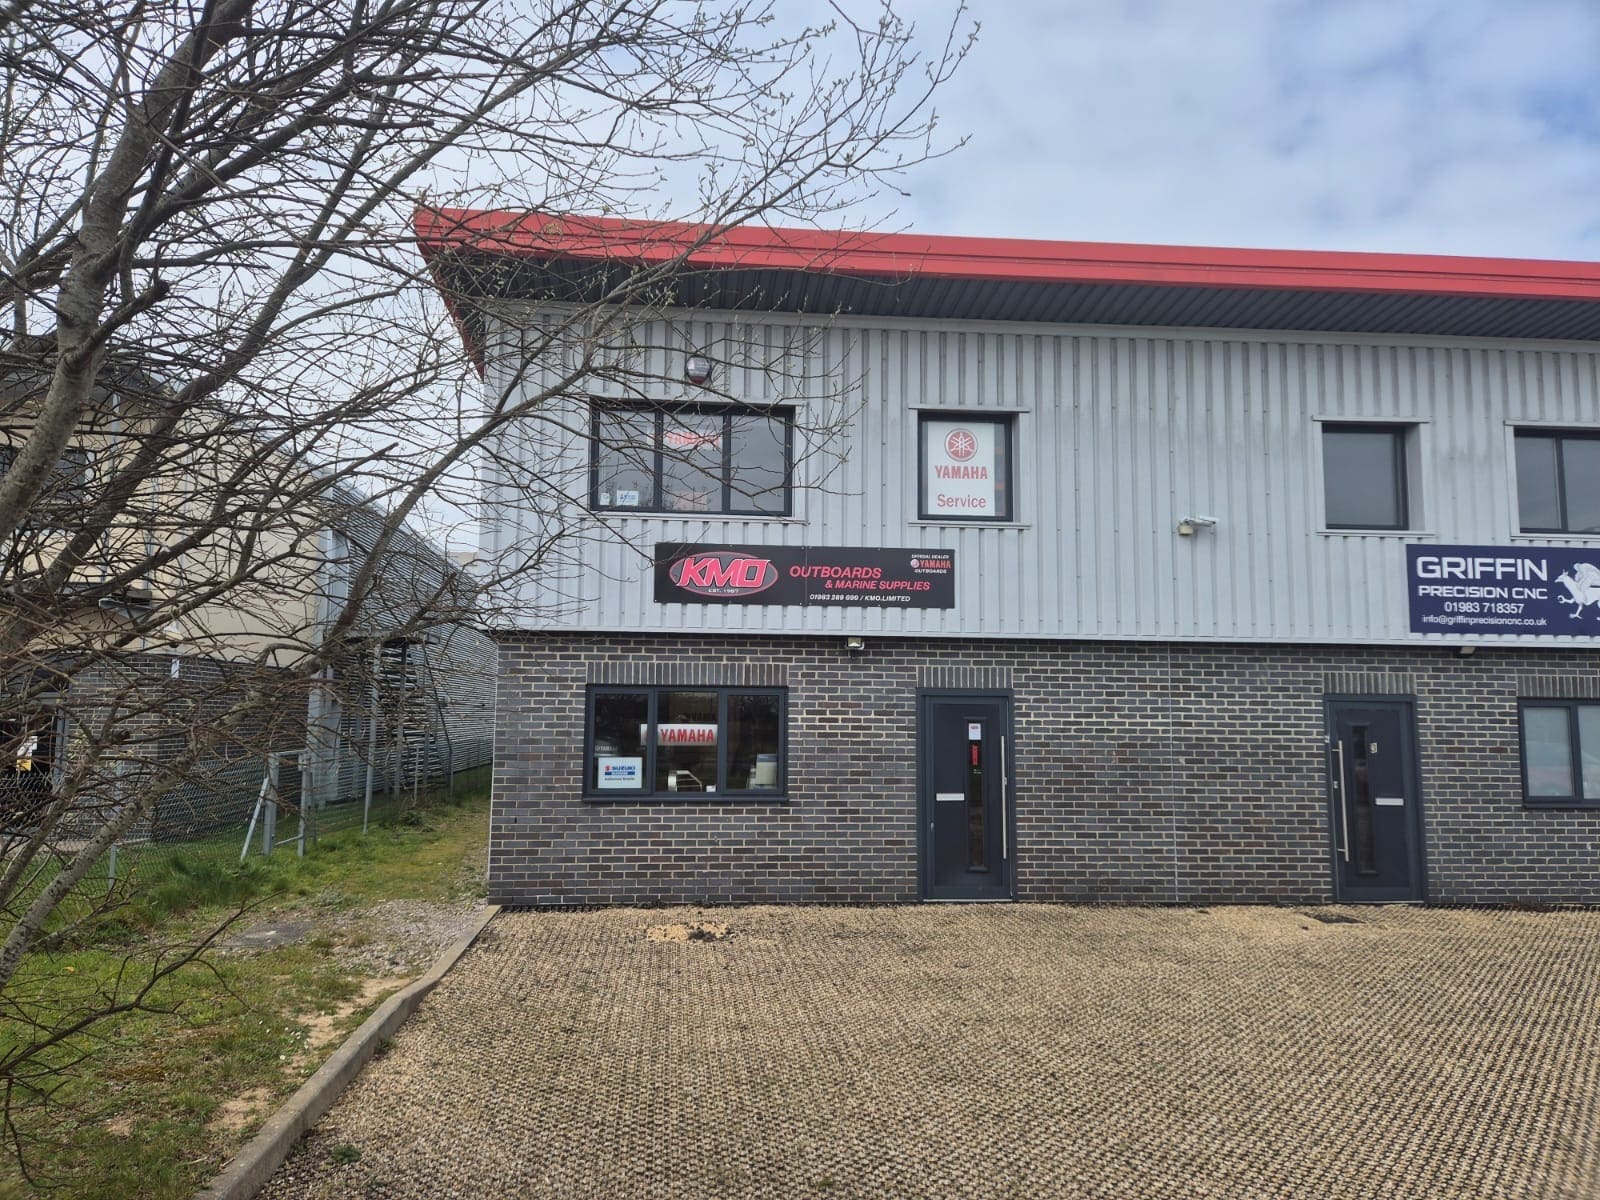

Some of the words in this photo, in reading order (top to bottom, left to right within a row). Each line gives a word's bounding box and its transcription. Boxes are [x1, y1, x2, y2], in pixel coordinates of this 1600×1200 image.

[935, 465, 988, 479] YAMAHA
[937, 493, 986, 508] Service
[920, 559, 951, 568] YAMAHA
[1416, 556, 1548, 581] GRIFFIN
[676, 557, 770, 587] KMO
[789, 565, 882, 579] OUTBOARDS
[825, 579, 833, 589] &
[835, 579, 877, 590] MARINE
[879, 580, 931, 591] SUPPLIES
[1418, 585, 1508, 599] PRECISION
[1511, 587, 1548, 599] CNC
[1444, 601, 1480, 613] 01983
[1482, 602, 1525, 614] 718357
[1422, 614, 1547, 626] info@griffinprecisioncnc.co.uk
[660, 728, 715, 742] YAMAHA
